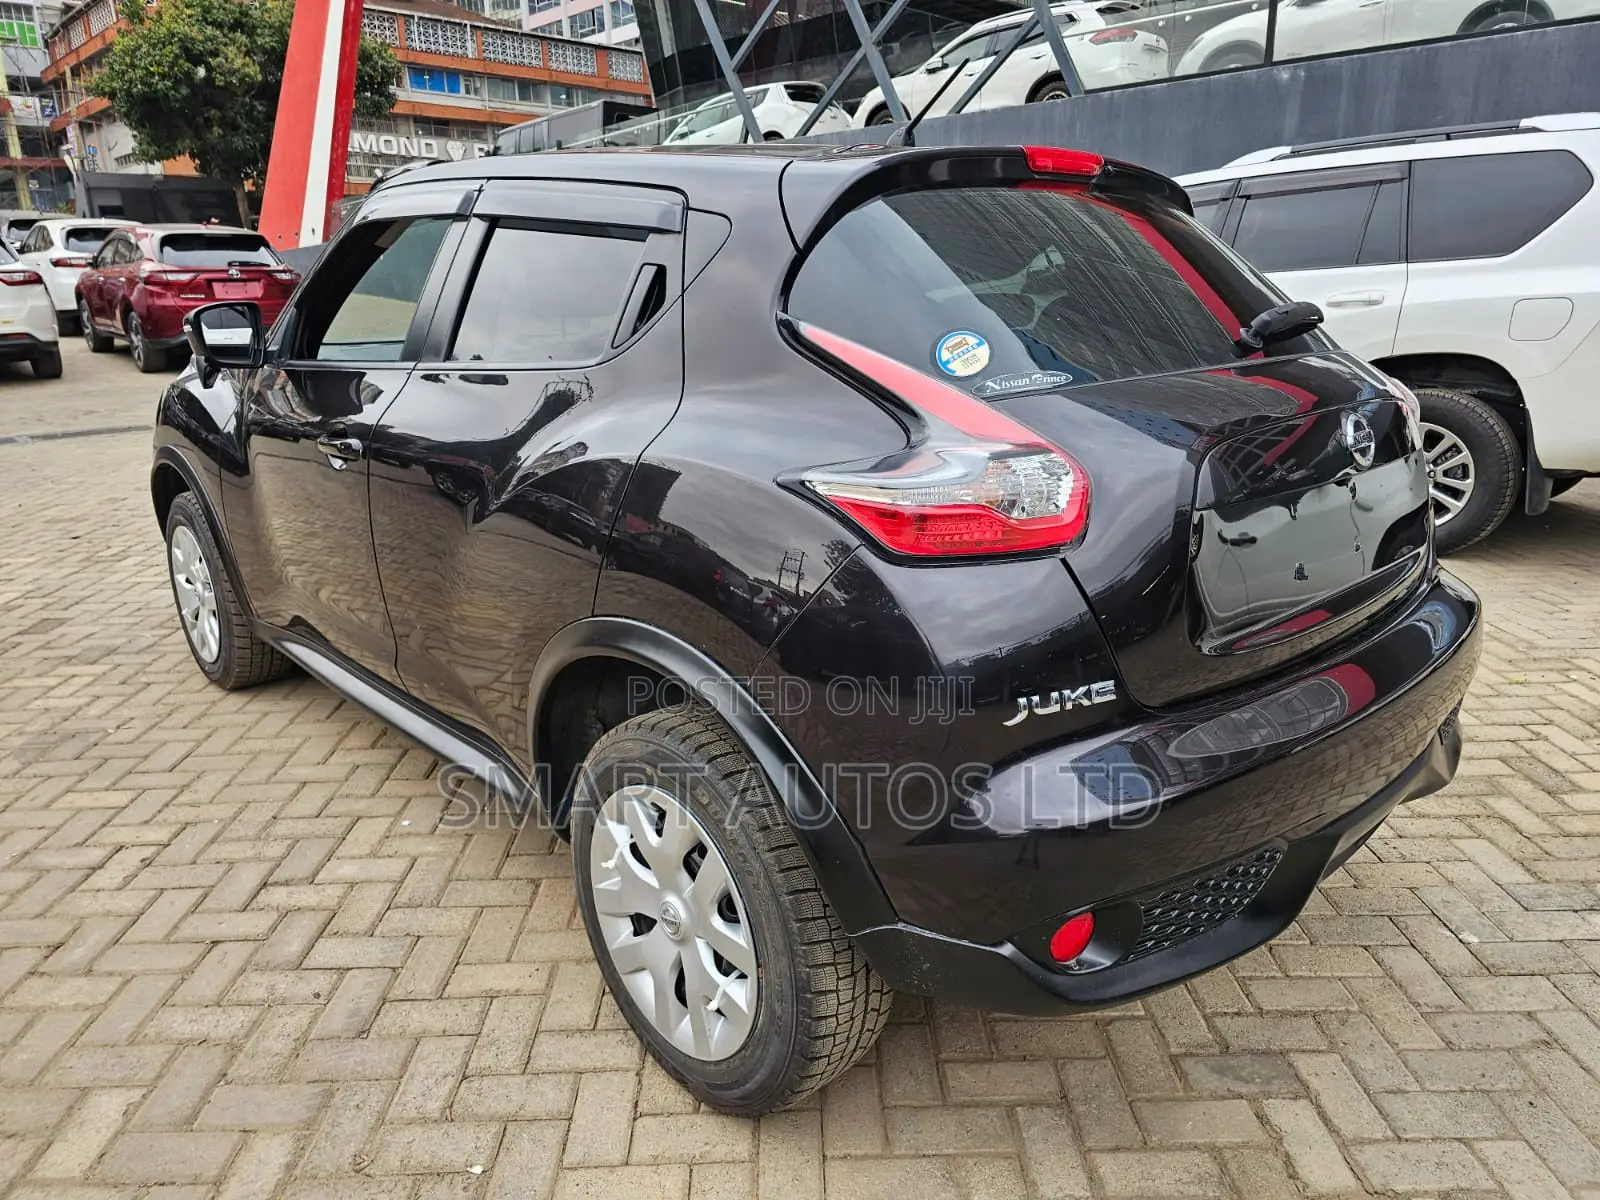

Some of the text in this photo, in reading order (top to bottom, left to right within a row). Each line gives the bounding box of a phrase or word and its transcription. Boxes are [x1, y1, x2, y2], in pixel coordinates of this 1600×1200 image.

[348, 132, 438, 158] MOND
[985, 374, 1066, 393] Nissan Prince
[1002, 680, 1117, 727] JUKE
